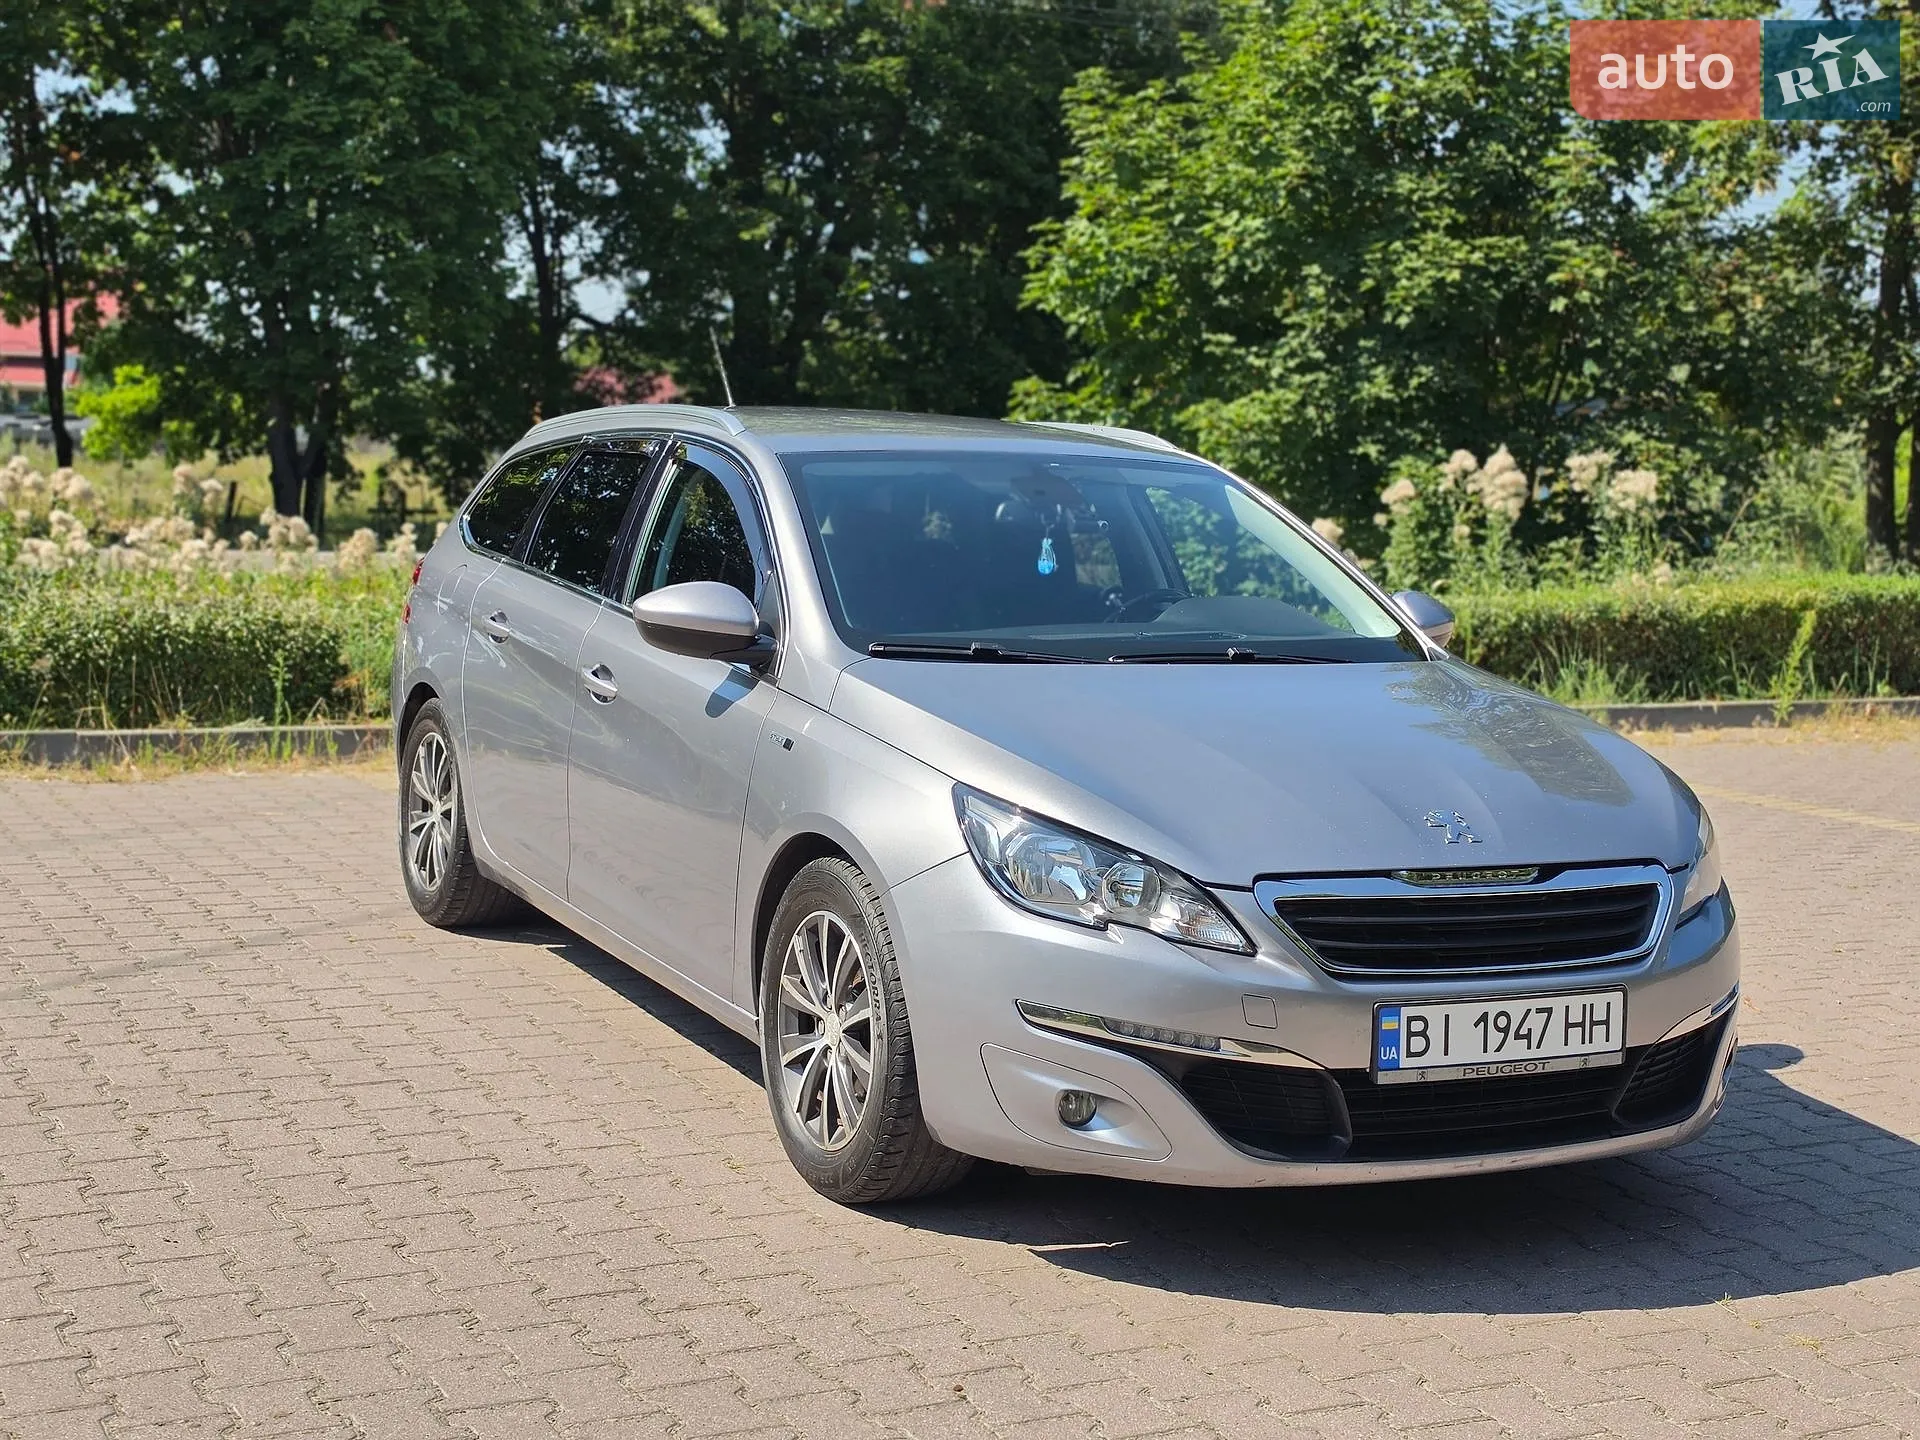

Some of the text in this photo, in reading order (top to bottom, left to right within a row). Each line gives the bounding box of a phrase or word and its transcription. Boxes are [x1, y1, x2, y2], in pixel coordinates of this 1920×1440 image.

[1405, 1002, 1611, 1058] BI 1947 HH
[1380, 1047, 1398, 1060] UA
[1462, 1061, 1550, 1077] PEUGEOT
